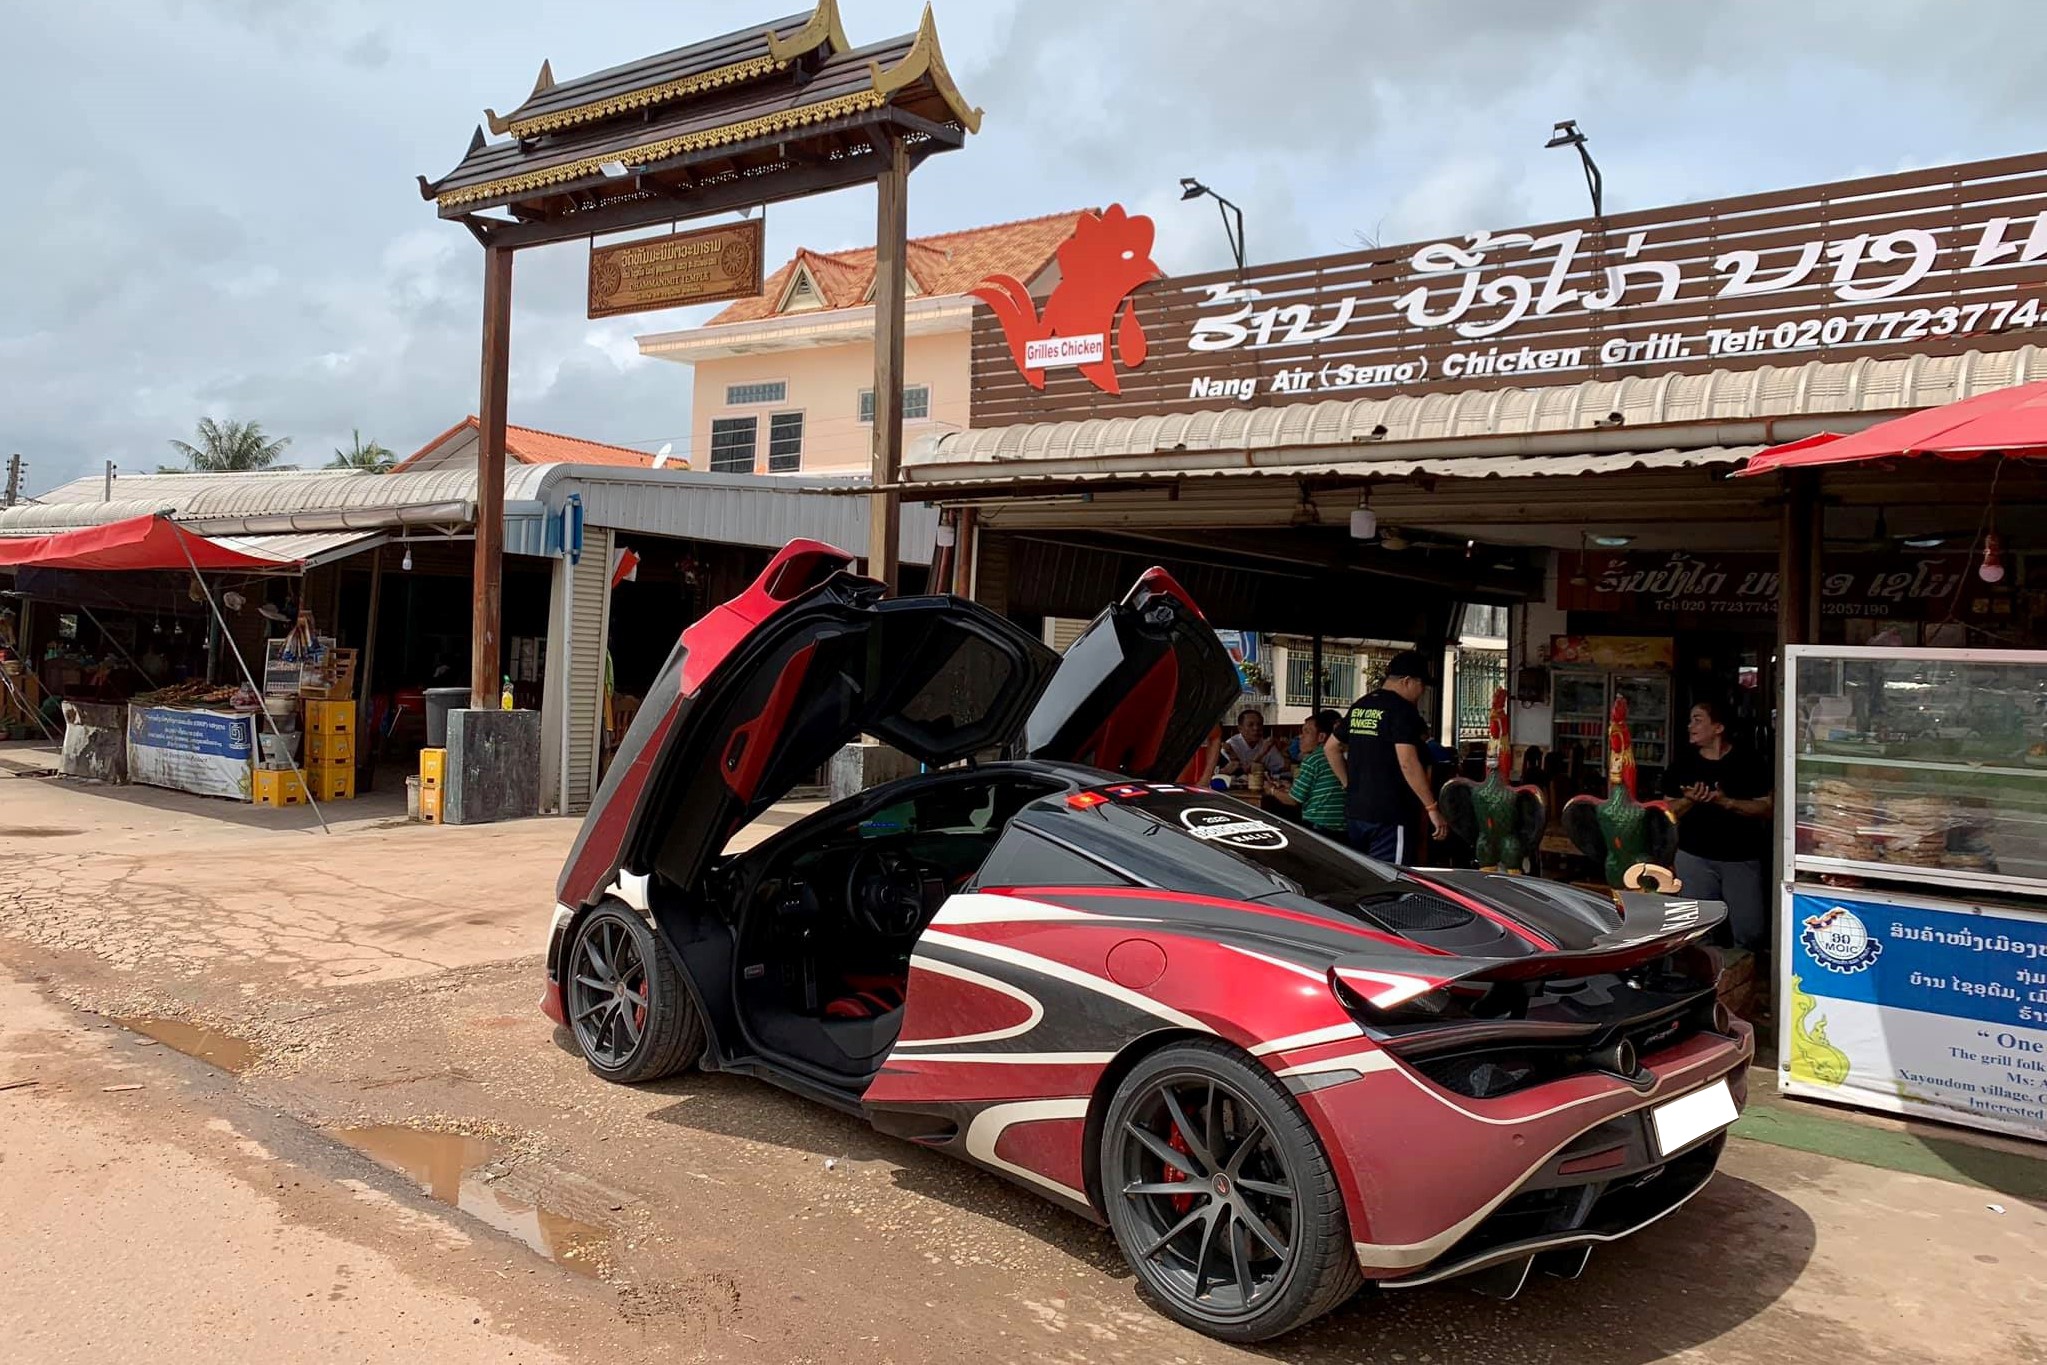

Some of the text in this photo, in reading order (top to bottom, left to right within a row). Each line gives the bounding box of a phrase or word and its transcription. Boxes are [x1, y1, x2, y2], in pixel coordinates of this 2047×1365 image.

[1027, 339, 1102, 360] Grilles Chicken
[1189, 376, 1257, 401] Nang
[1271, 367, 1314, 392] Air
[1442, 346, 1582, 377] Chicken
[1600, 333, 1690, 363] Grill.
[1824, 942, 1860, 955] MOIC
[1997, 1033, 2045, 1053] One
[1948, 1046, 2047, 1073] The grill folk
[1898, 1067, 1976, 1092] Xayoudom
[2007, 1072, 2034, 1086] Ms:
[1968, 1096, 2044, 1120] Interested
